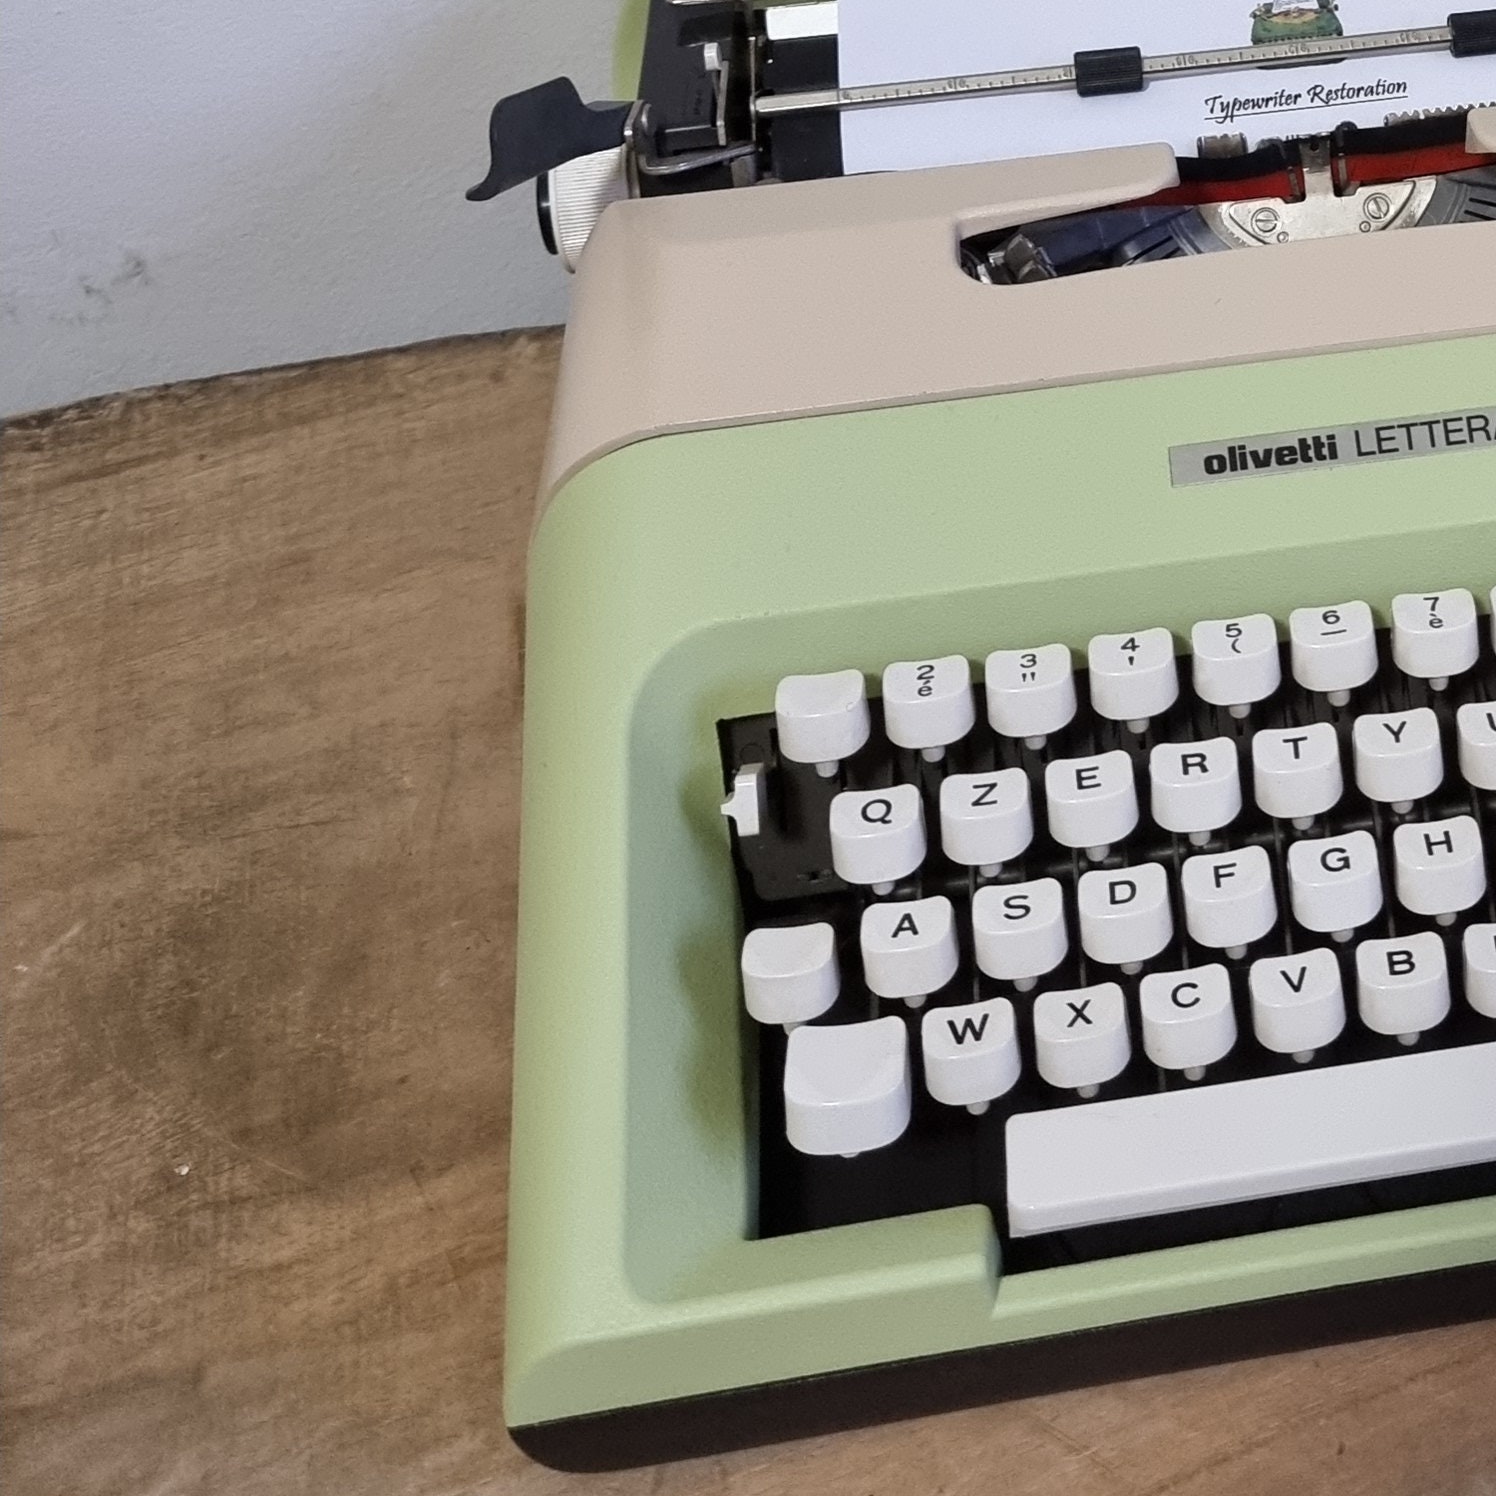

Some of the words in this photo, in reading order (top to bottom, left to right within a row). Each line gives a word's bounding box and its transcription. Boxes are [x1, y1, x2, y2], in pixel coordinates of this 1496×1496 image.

[1204, 88, 1302, 124] Typewriter
[1306, 77, 1408, 106] Restoration
[1203, 433, 1339, 476] olivetti
[1423, 596, 1440, 612] 7
[1225, 622, 1243, 638] 5
[1322, 610, 1341, 625] 6
[1428, 613, 1444, 629] è
[1120, 637, 1140, 652] 4
[916, 664, 935, 681] 2
[1019, 653, 1037, 669] 3
[917, 680, 933, 697] é
[1382, 720, 1407, 744] Y
[1282, 736, 1308, 760] T
[1180, 752, 1209, 776] R
[1075, 766, 1102, 791] E
[971, 782, 998, 807] Z
[860, 798, 892, 825] Q
[1423, 830, 1454, 856] H
[1320, 847, 1351, 873] G
[1213, 862, 1237, 889] F
[1108, 880, 1137, 905] D
[1003, 895, 1031, 920] S
[891, 912, 919, 939] A
[1386, 950, 1416, 976] B
[1280, 966, 1307, 993] V
[1171, 982, 1201, 1009] C
[1066, 999, 1093, 1028] X
[947, 1013, 990, 1044] W
